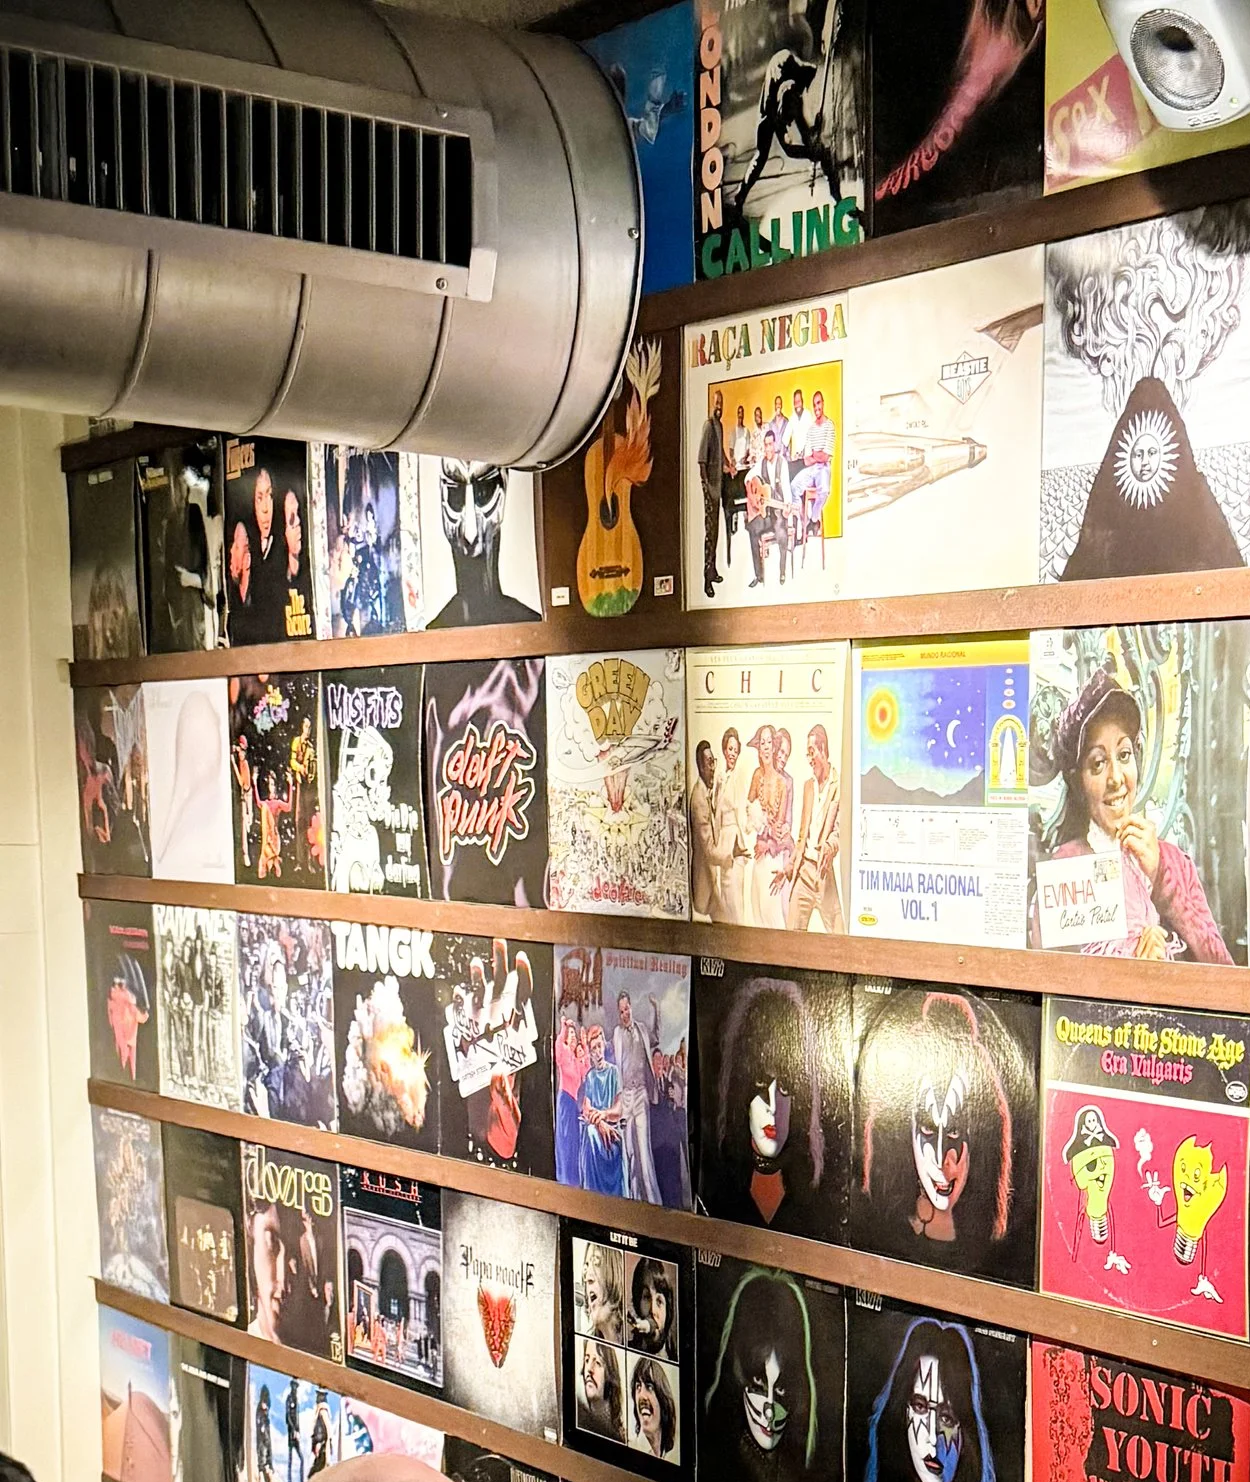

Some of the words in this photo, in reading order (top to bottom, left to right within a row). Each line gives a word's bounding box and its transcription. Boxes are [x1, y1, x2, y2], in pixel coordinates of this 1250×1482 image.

[702, 196, 861, 281] CALLING
[691, 323, 752, 371] RAÇA
[760, 303, 847, 354] NEGRA
[575, 657, 651, 710] GREEN
[586, 698, 642, 741] DAY
[447, 730, 531, 797] daft
[442, 770, 530, 854] punk
[858, 869, 880, 892] TIM
[882, 871, 914, 893] MAIA
[917, 872, 983, 898] RACIONAL
[1043, 879, 1097, 910] EVINHA
[331, 920, 436, 980] TANGK
[1056, 1014, 1112, 1047] Queens
[1114, 1020, 1132, 1050] of
[1134, 1022, 1158, 1053] the
[1160, 1025, 1207, 1060] Stone
[1207, 1033, 1246, 1071] Age
[1131, 1051, 1194, 1085] Vulgaris
[1090, 1365, 1213, 1440] SONIC
